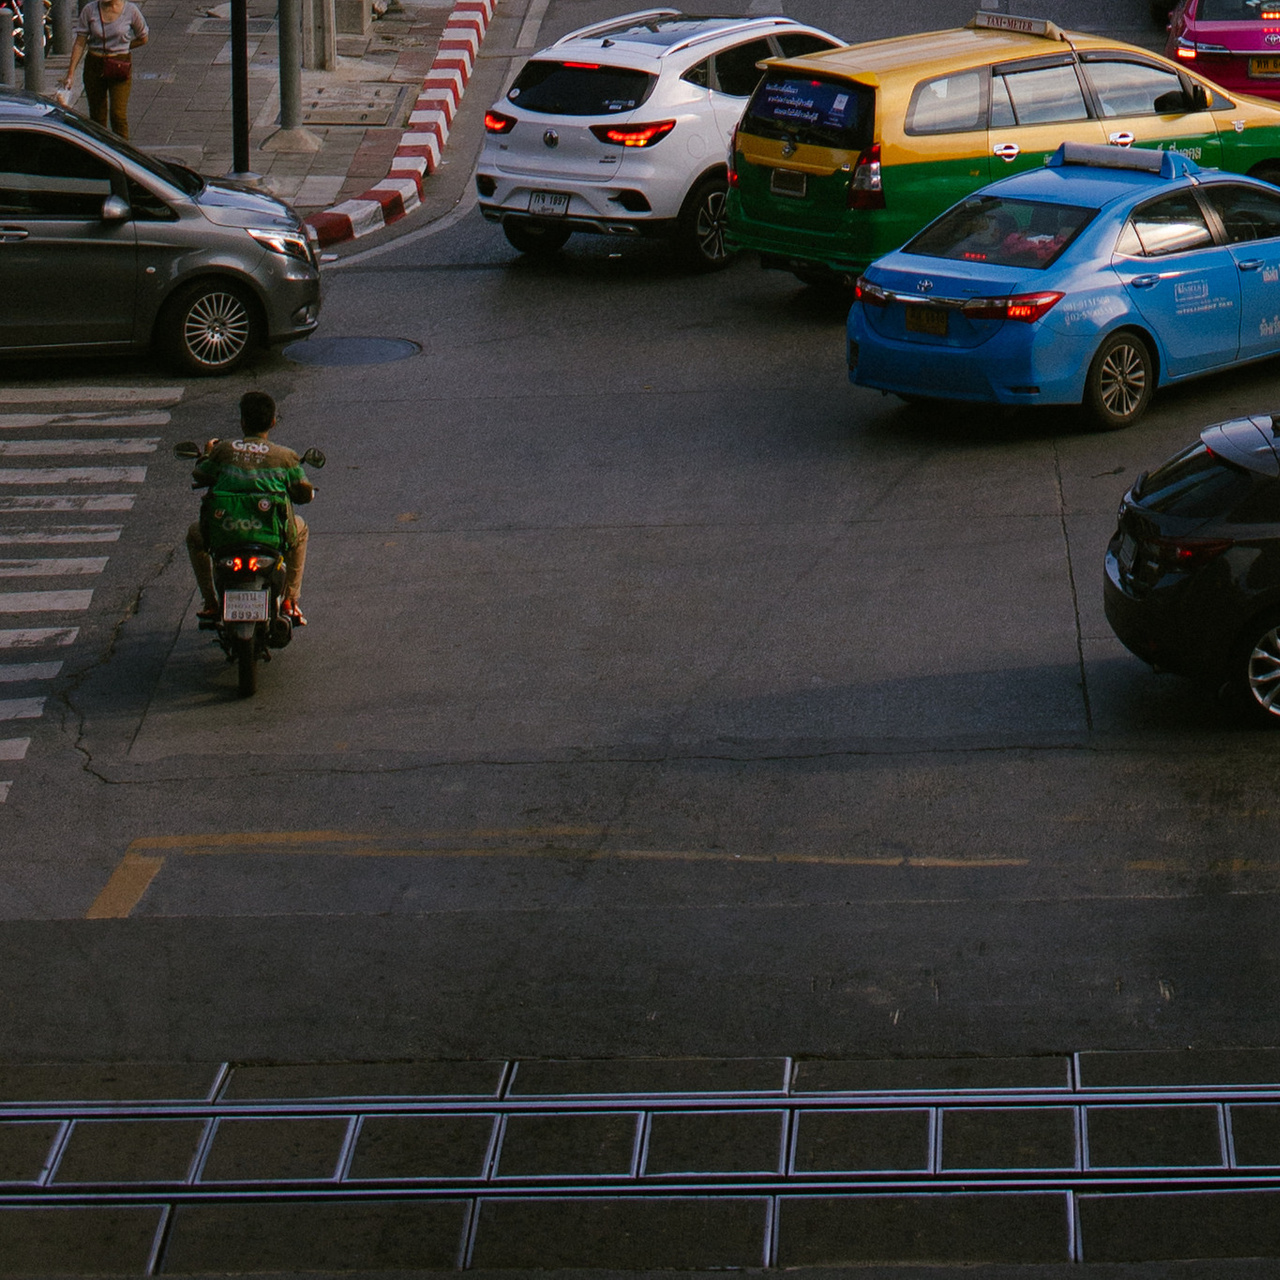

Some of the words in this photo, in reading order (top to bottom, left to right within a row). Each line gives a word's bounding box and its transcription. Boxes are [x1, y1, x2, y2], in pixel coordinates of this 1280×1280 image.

[549, 194, 567, 207] 1997
[231, 439, 270, 454] Grab
[221, 517, 263, 531] Grab
